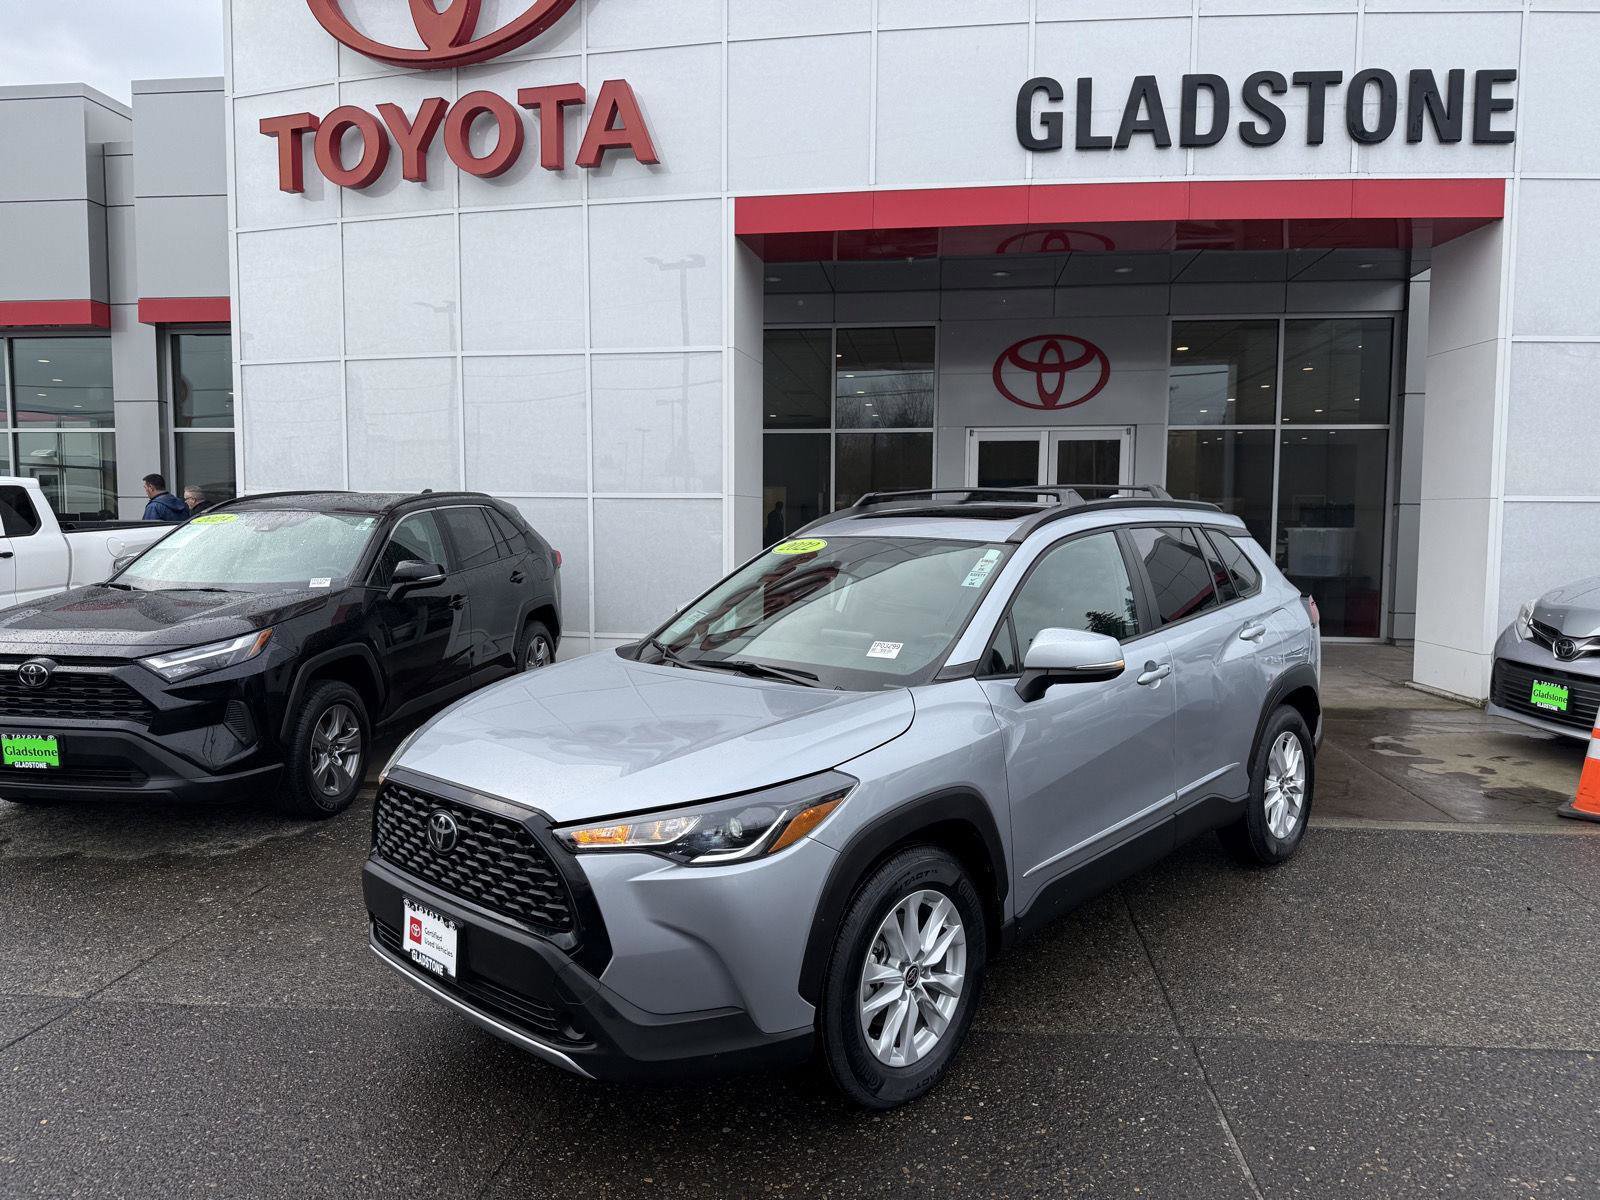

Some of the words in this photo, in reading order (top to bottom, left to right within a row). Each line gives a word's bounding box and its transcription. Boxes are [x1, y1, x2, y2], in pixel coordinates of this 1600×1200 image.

[1016, 68, 1517, 151] GLADSTONE
[259, 79, 660, 193] TOYOTA
[1533, 689, 1568, 703] Gladstone
[4, 745, 58, 757] Gladstone
[14, 761, 48, 769] GLADSTONE
[411, 949, 445, 977] GLADSTONE
